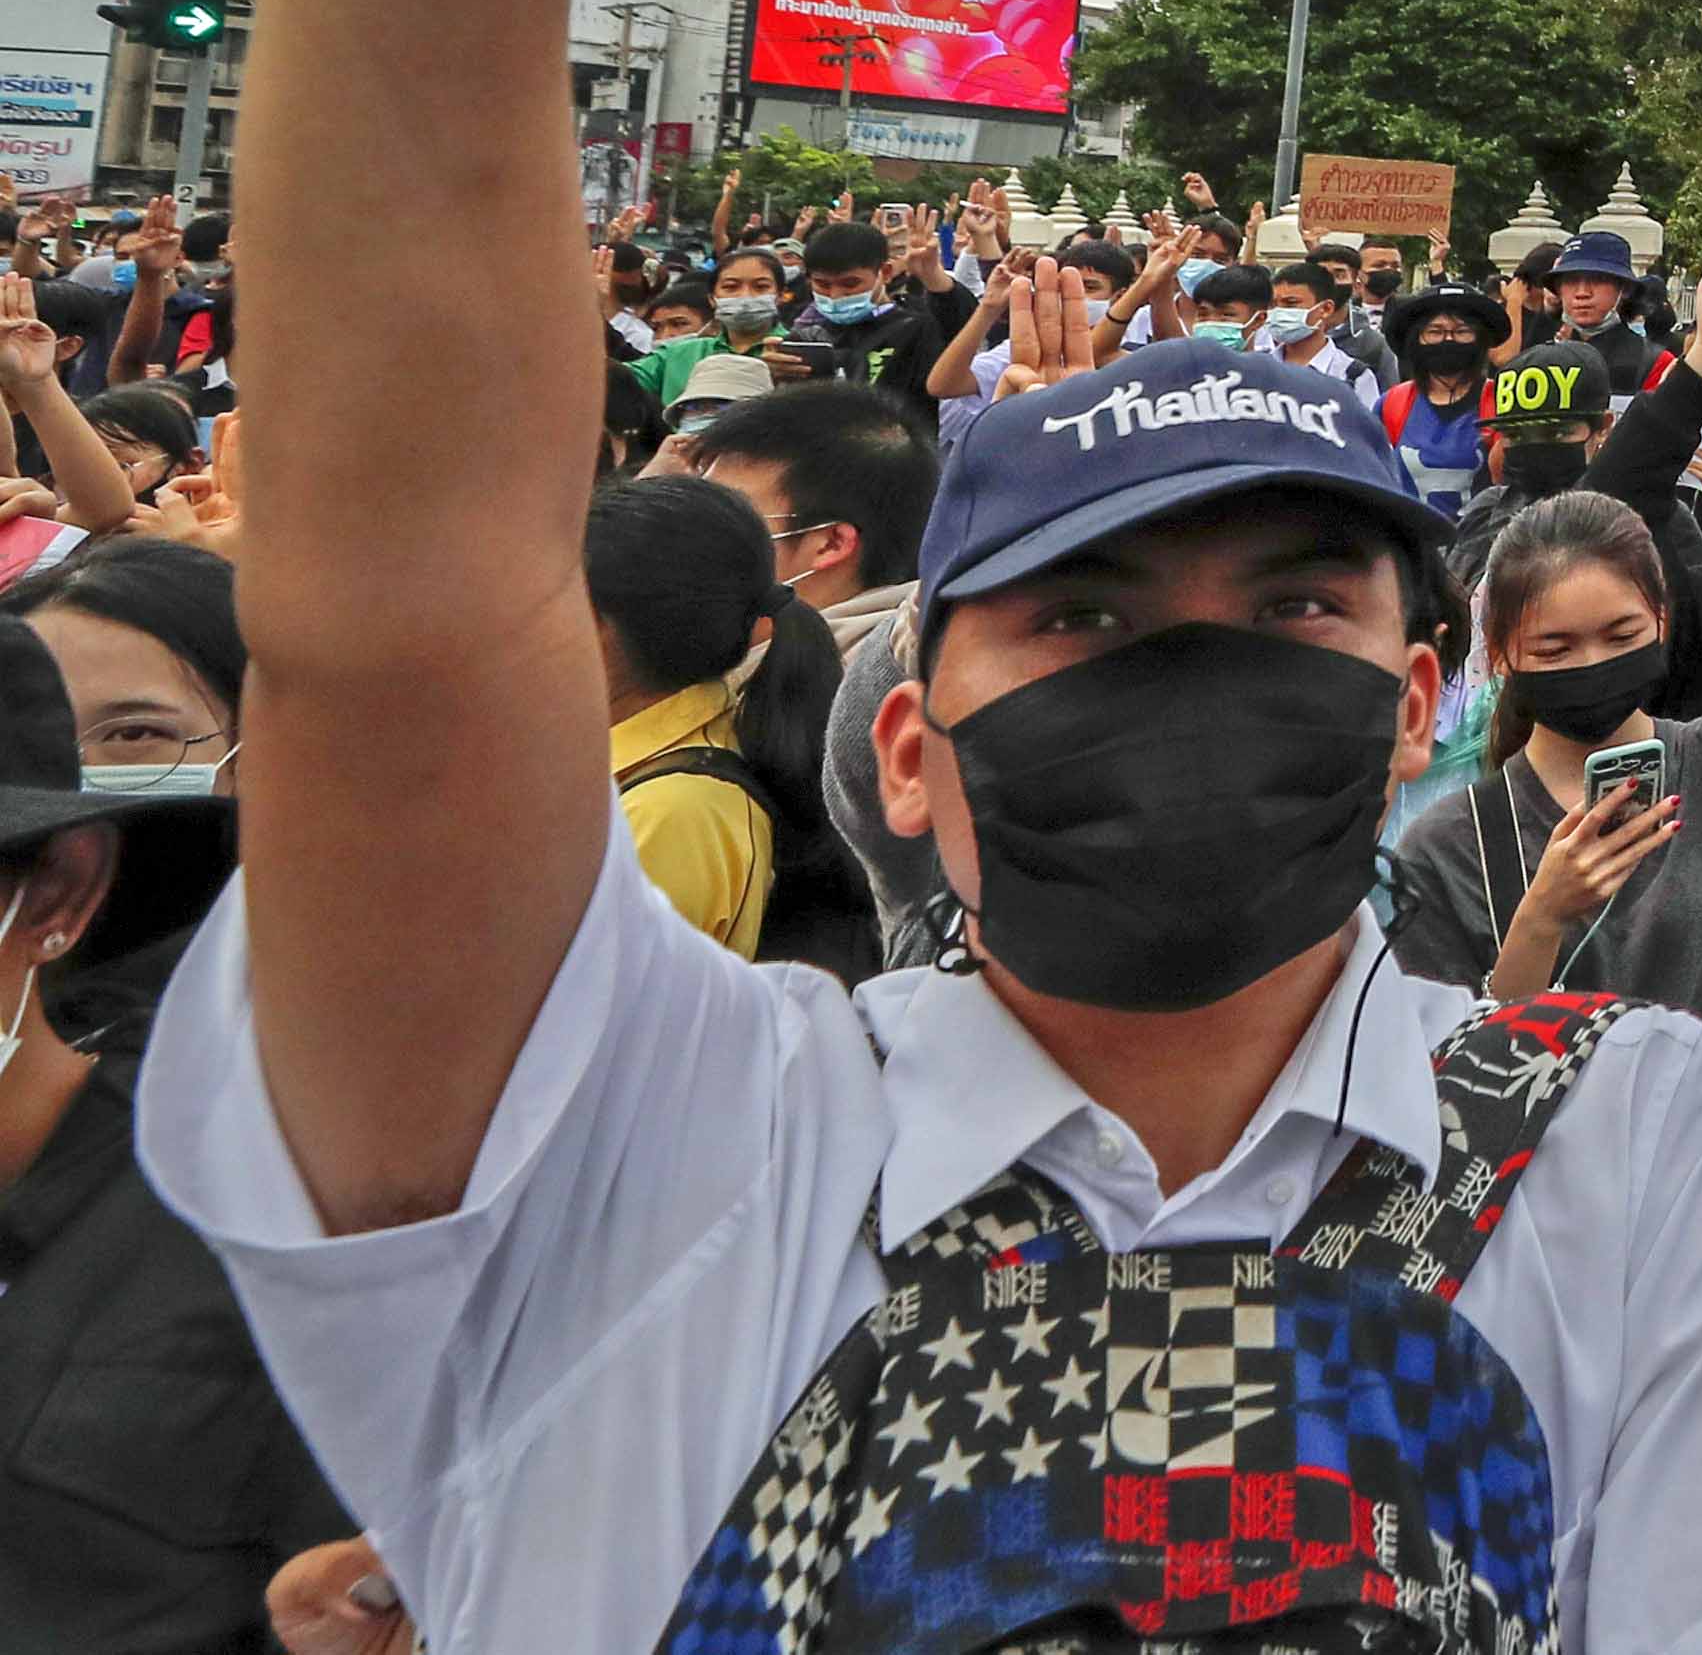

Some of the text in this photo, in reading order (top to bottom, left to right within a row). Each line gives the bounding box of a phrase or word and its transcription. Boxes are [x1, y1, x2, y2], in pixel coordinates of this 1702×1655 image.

[178, 185, 193, 203] 2
[1042, 370, 1347, 450] Thailand
[1496, 366, 1582, 415] BOY
